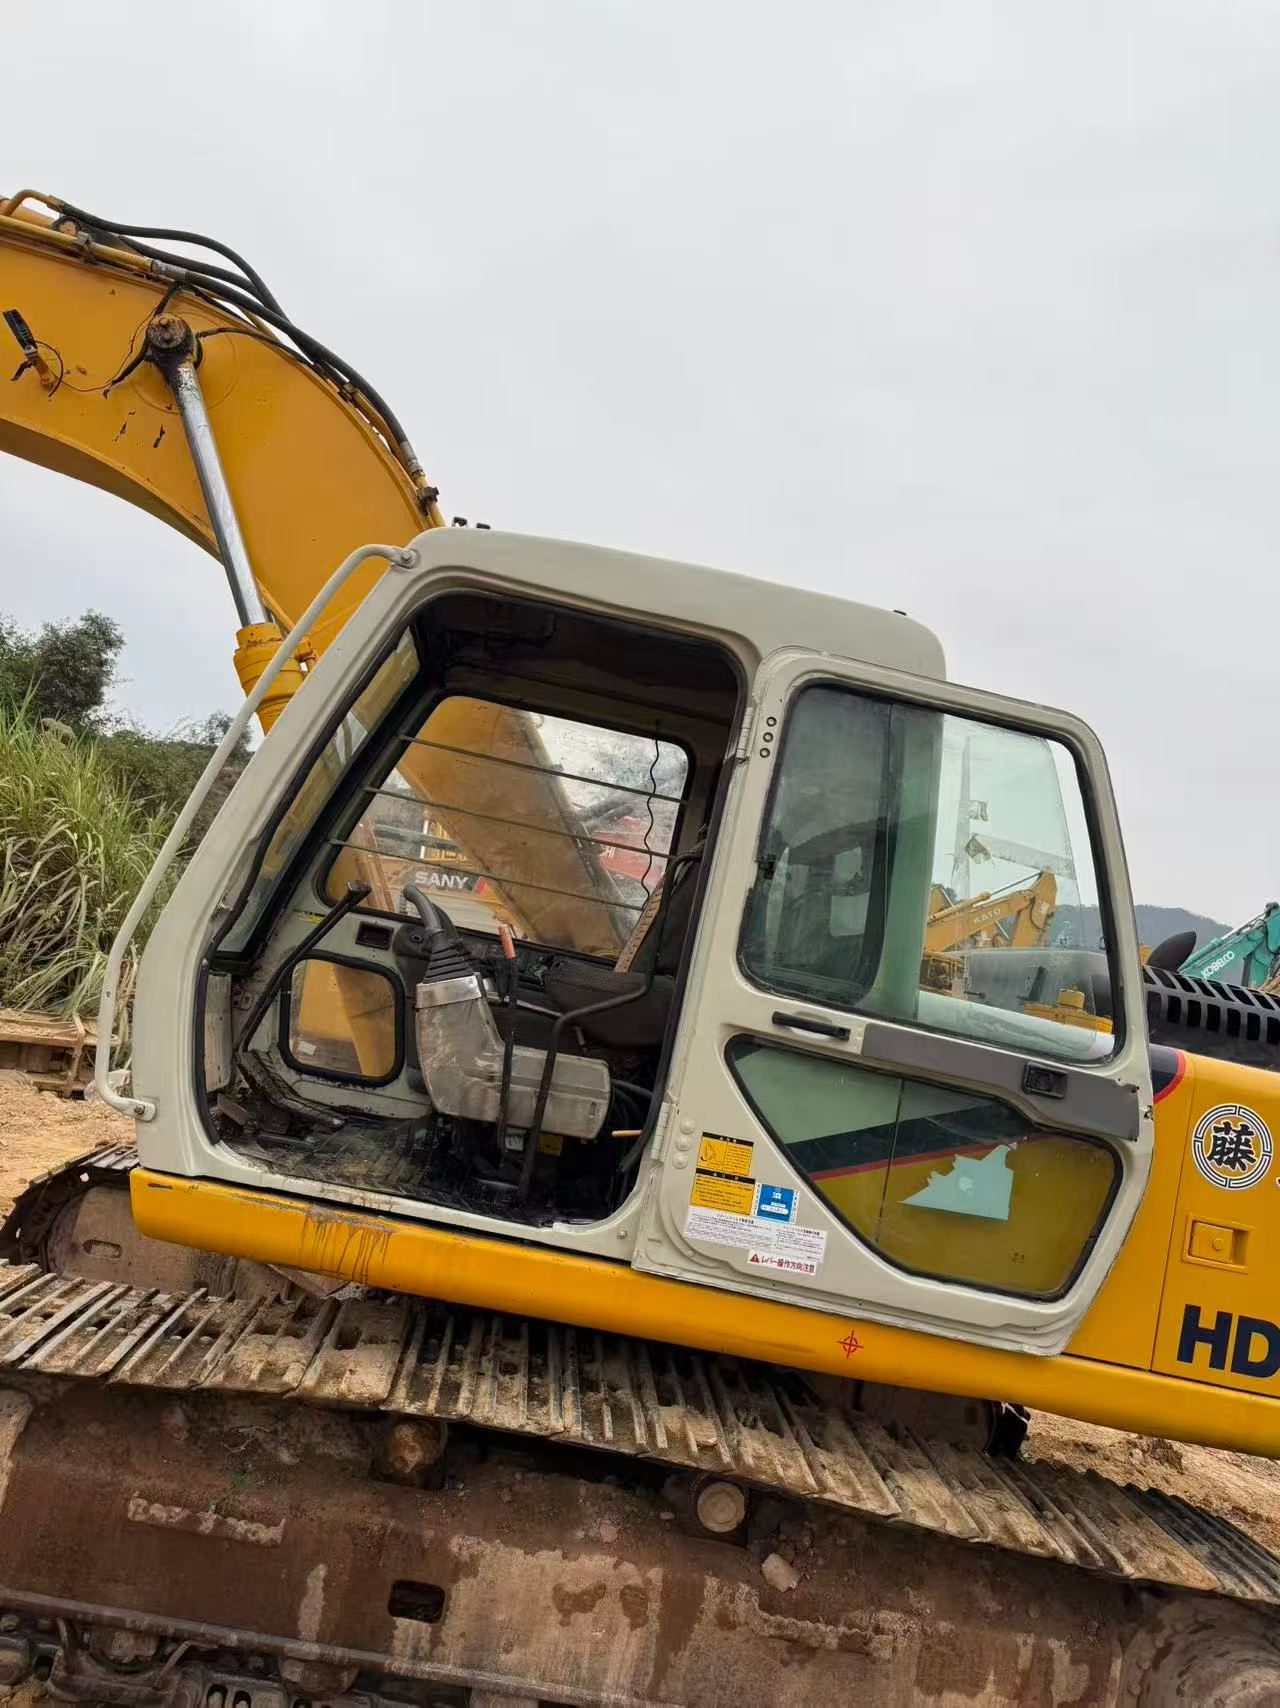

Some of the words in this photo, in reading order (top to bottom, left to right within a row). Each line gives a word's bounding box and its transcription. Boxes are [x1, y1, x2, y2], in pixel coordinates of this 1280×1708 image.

[415, 870, 468, 889] SANY
[974, 908, 1001, 924] KATO
[1200, 950, 1235, 979] KOBELCO
[1206, 1120, 1258, 1173] 藤
[1176, 1303, 1280, 1379] HD
